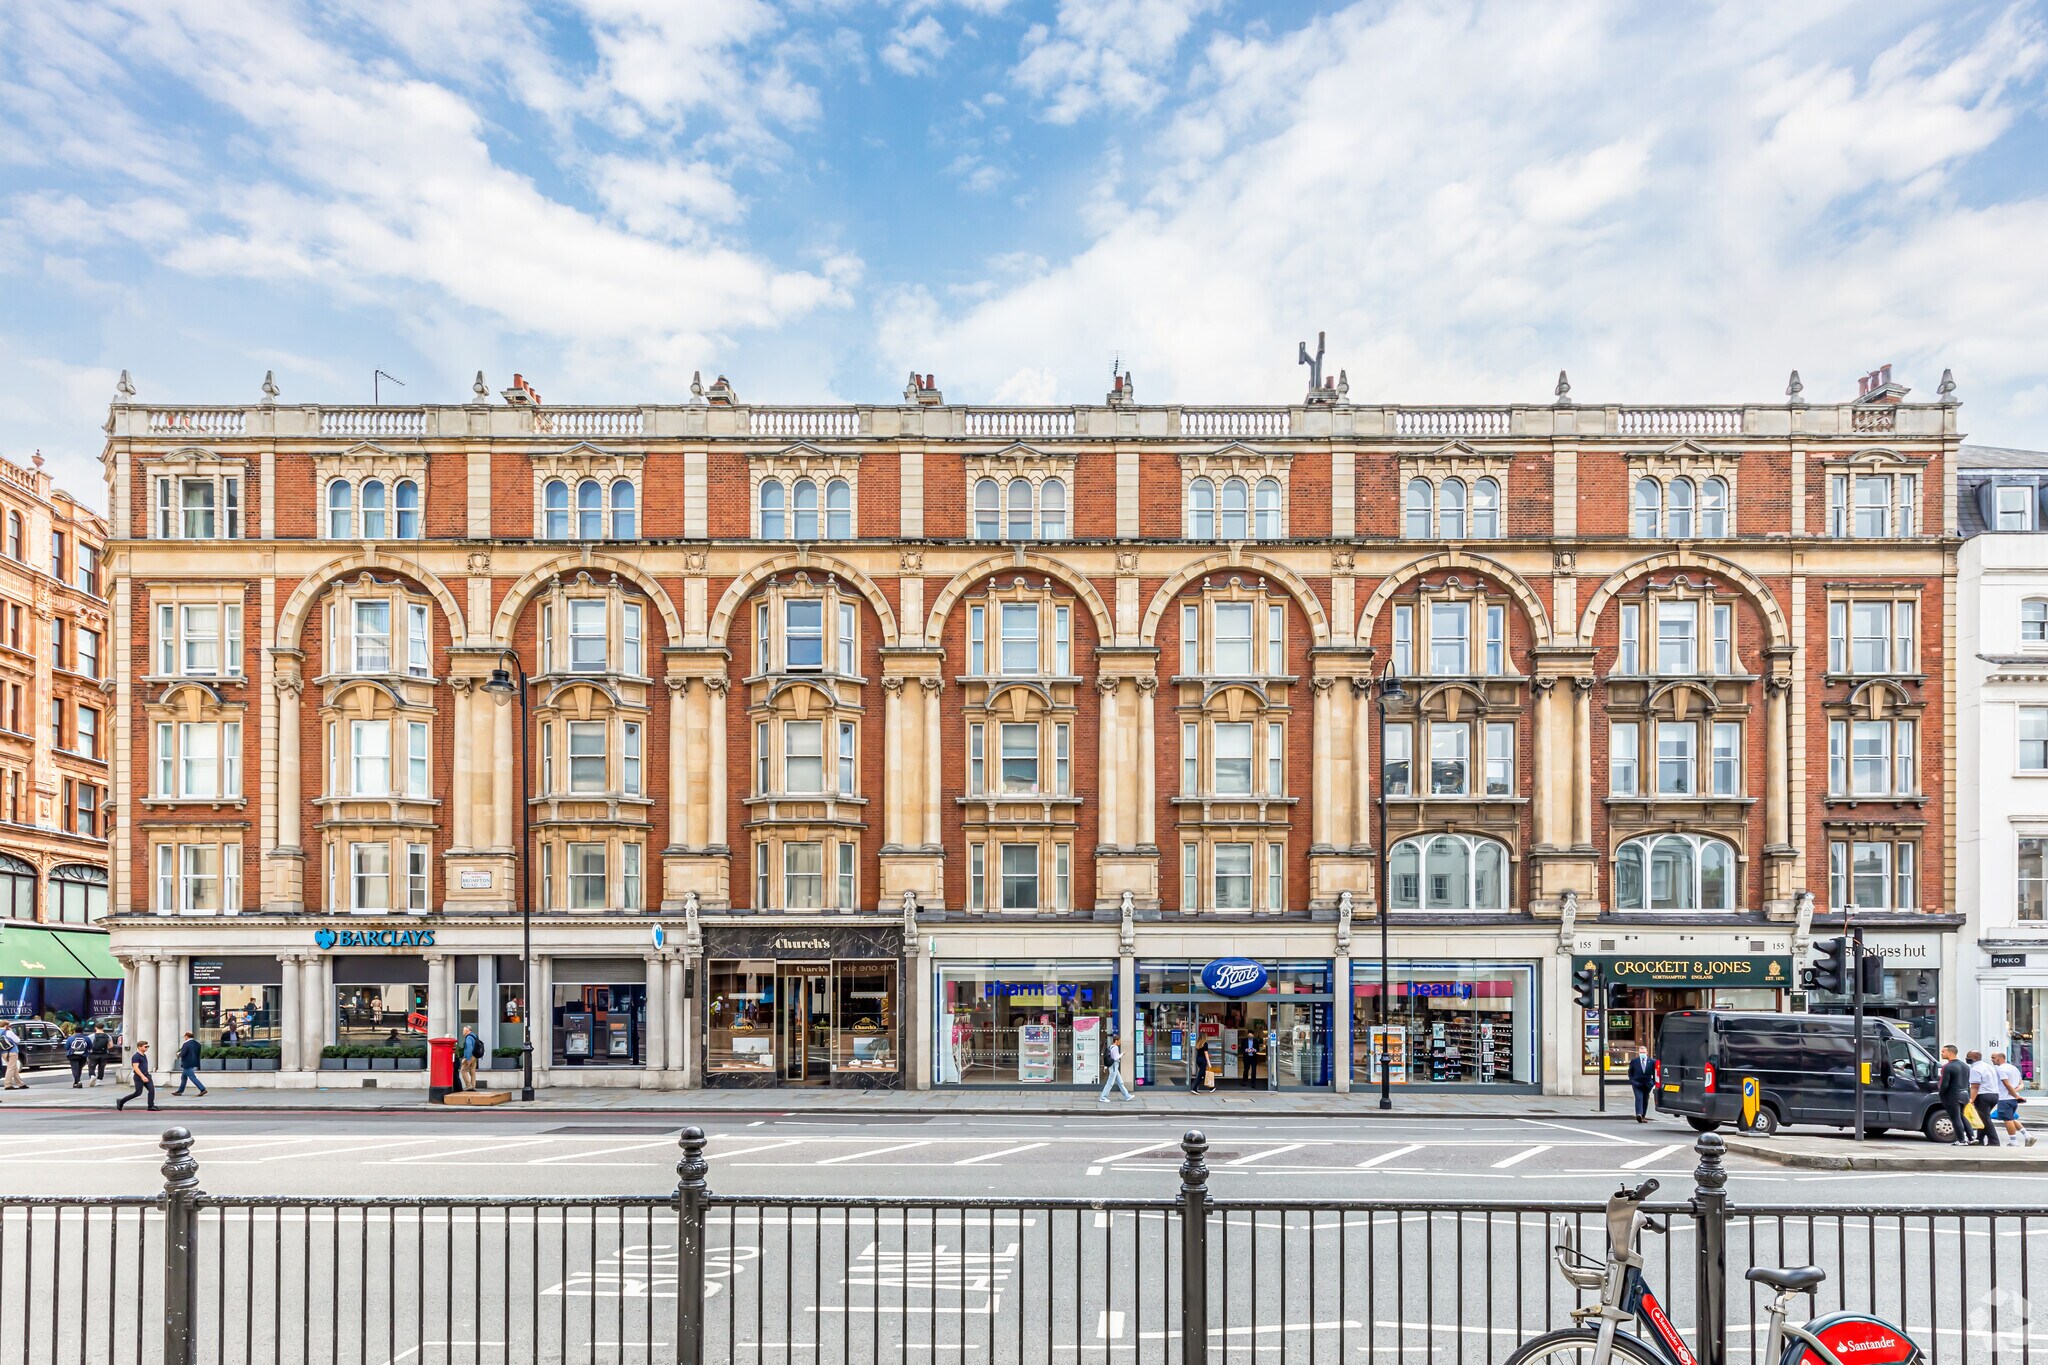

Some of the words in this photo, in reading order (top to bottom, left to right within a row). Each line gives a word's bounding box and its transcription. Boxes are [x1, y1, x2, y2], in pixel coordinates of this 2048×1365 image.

[340, 930, 435, 946] BARCLAYS
[775, 938, 831, 949] Church's
[1904, 943, 1926, 957] hut
[1614, 960, 1690, 975] CROCKETT
[1693, 961, 1702, 973] &
[1704, 961, 1751, 975] JONES
[1211, 965, 1259, 990] Boots
[984, 980, 1078, 998] pharmacy
[1407, 980, 1472, 999] beauty
[1989, 1040, 1999, 1048] 161
[539, 1245, 767, 1298] BUS
[1659, 1317, 1679, 1346] Santander
[1847, 1336, 1895, 1352] Santander
